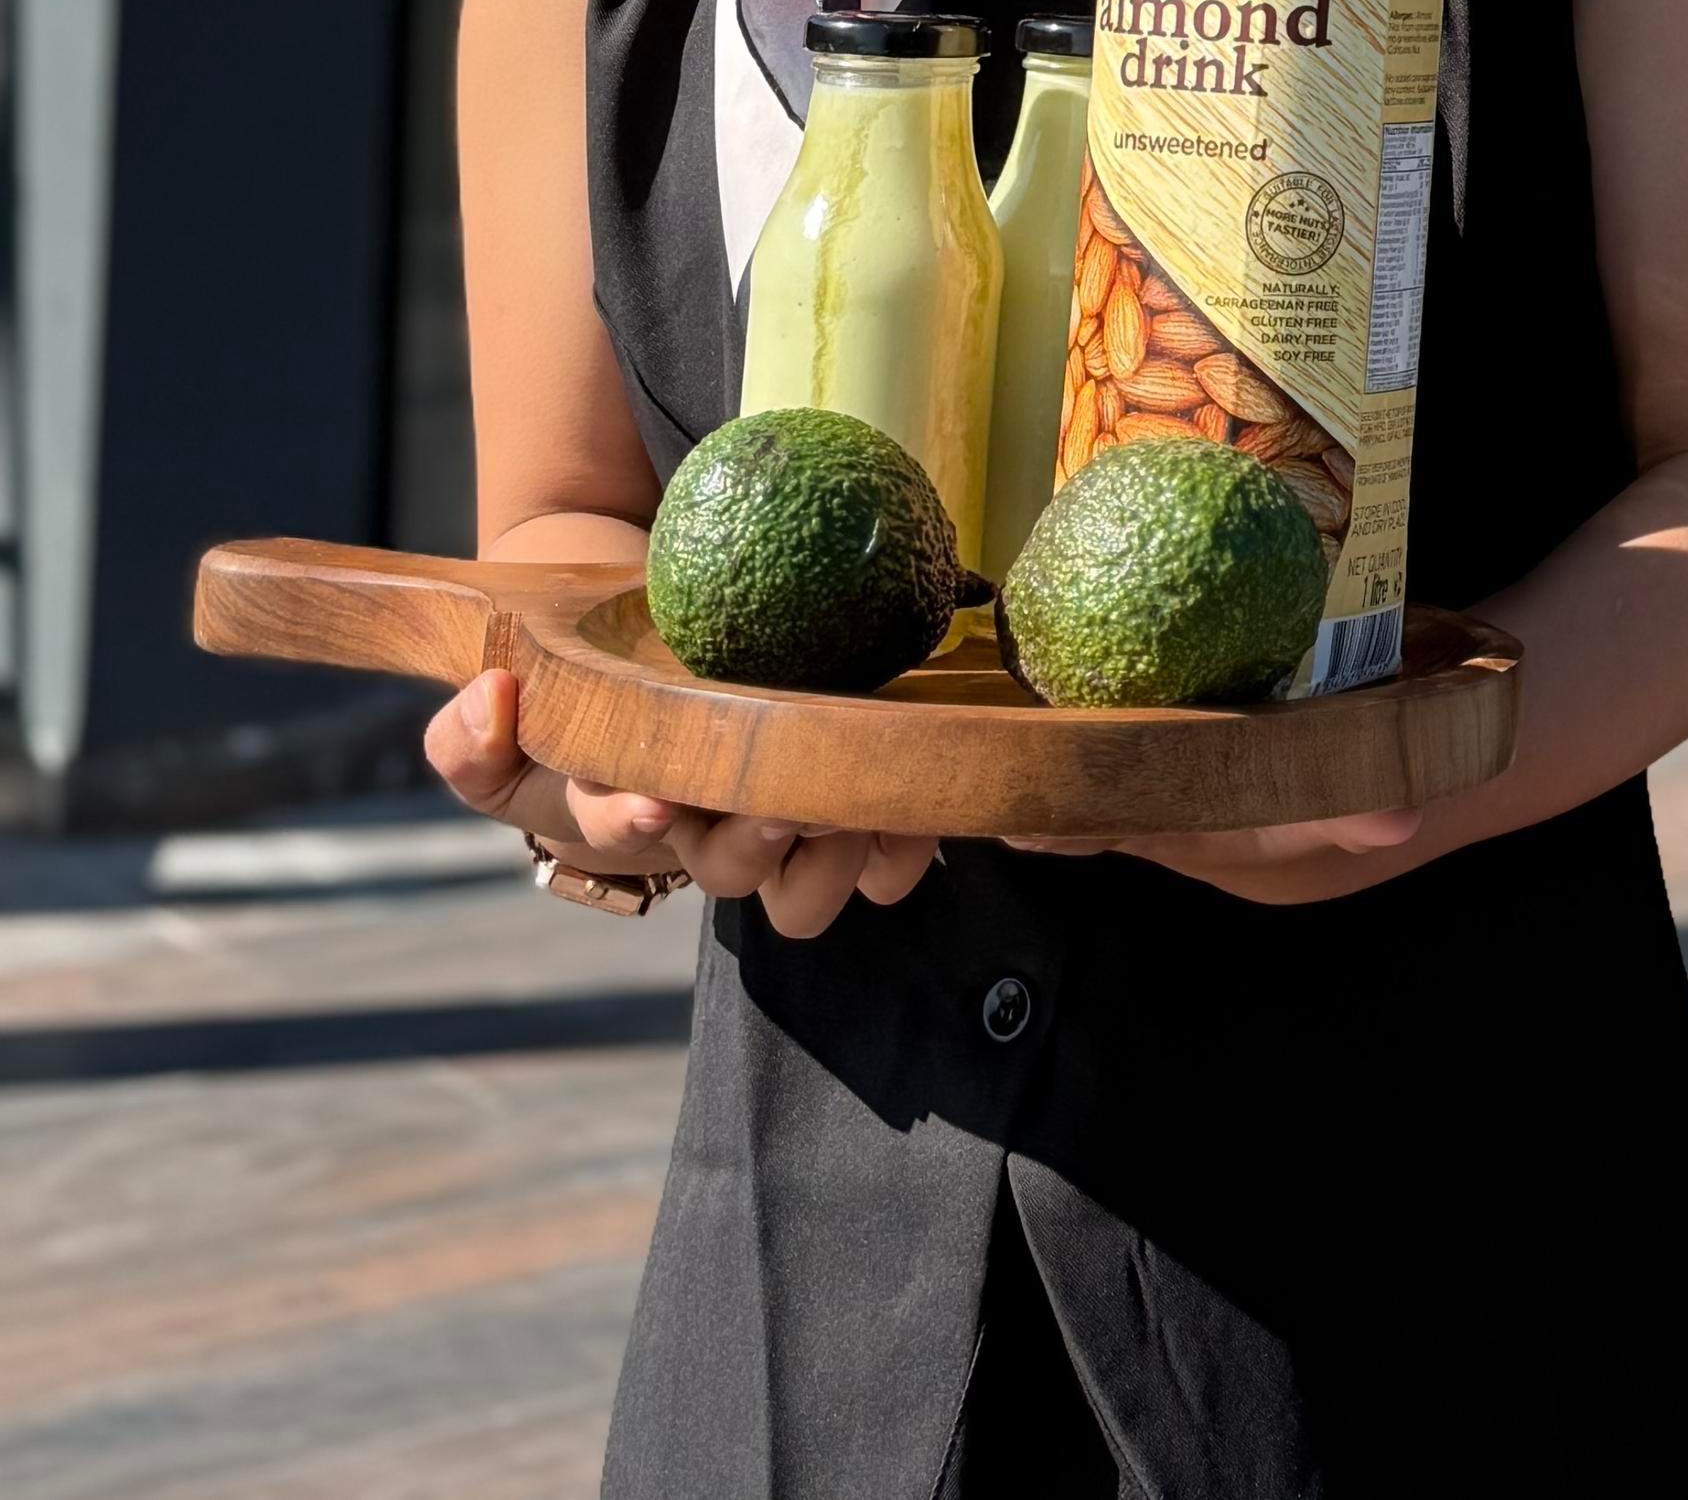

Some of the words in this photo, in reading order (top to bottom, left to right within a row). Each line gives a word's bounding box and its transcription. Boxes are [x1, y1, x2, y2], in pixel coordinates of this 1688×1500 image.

[1120, 37, 1269, 97] drink
[1114, 131, 1269, 161] unsweetened
[1266, 209, 1298, 224] MORE
[1267, 221, 1321, 242] TASTIER!
[1205, 296, 1304, 311] CARRAGEENAN
[1307, 300, 1339, 312] FREE
[1251, 316, 1305, 328] GLUTEN
[1306, 317, 1337, 328] FREE
[1261, 333, 1302, 345] DAIRY
[1305, 334, 1337, 345] FREE
[1274, 350, 1301, 362] SOY
[1304, 351, 1335, 362] FREE
[1347, 556, 1367, 577] NET
